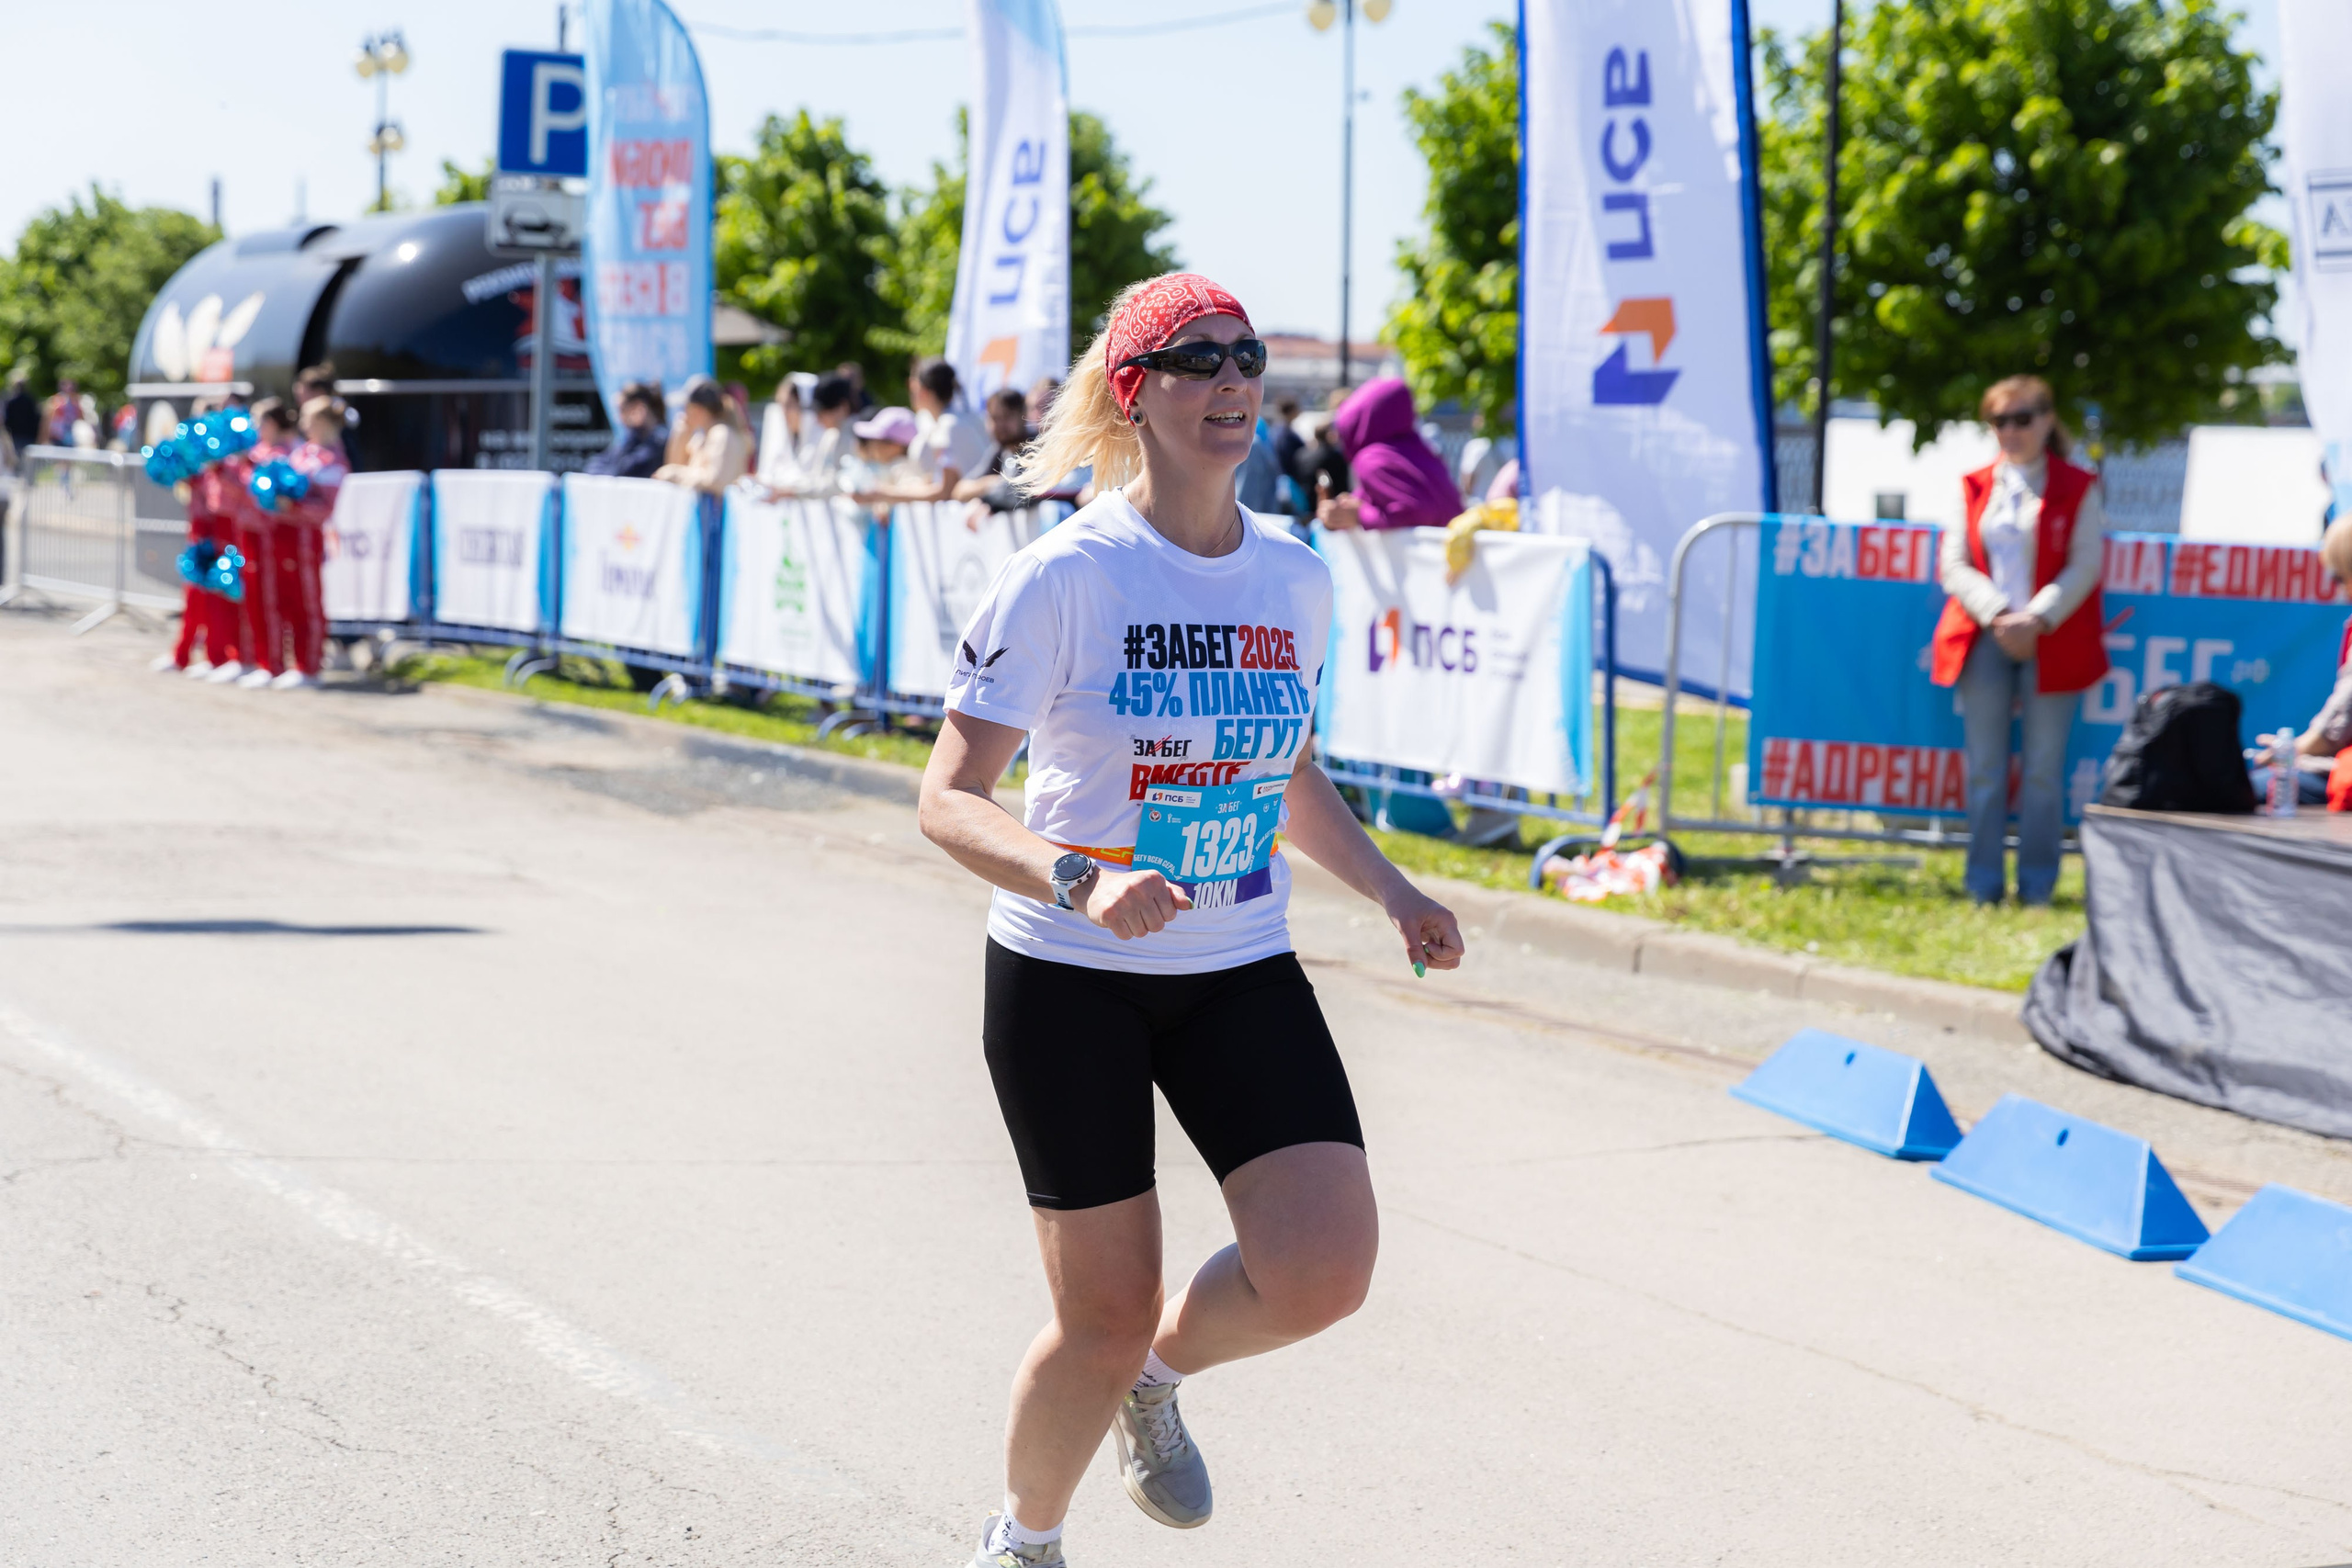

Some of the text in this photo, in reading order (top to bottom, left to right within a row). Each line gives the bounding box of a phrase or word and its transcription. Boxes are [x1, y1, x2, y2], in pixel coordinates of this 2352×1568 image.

[1773, 520, 1930, 583] #ЗАБЕГ
[1124, 624, 1301, 671] #ЗАБЕГ2025
[1411, 625, 1477, 672] ПСБ
[1108, 671, 1183, 717] 45%
[1212, 718, 1303, 761] БЕГУТ
[1164, 794, 1184, 803] ПСБ
[1180, 813, 1258, 878] 1323
[1193, 878, 1238, 909] 10КМ
